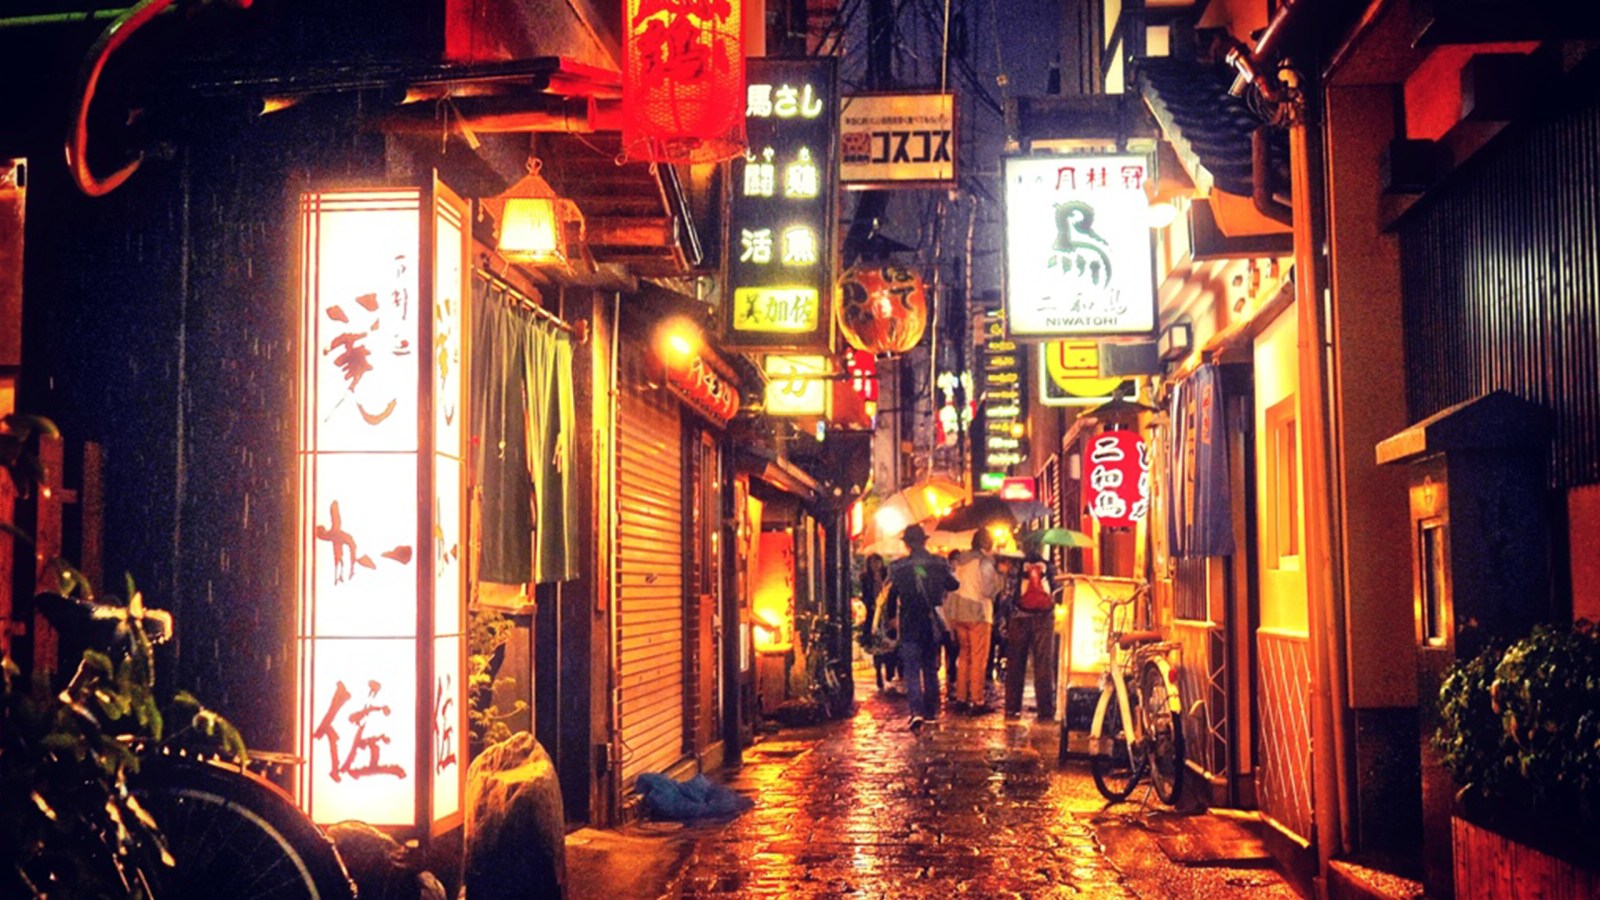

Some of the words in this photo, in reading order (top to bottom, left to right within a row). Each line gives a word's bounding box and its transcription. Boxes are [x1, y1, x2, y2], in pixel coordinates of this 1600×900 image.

[747, 84, 823, 118] 馬さし
[872, 131, 951, 163] コスコス
[1055, 165, 1144, 191] 月桂冠
[740, 228, 816, 264] 活魚
[739, 292, 814, 323] 美加佐
